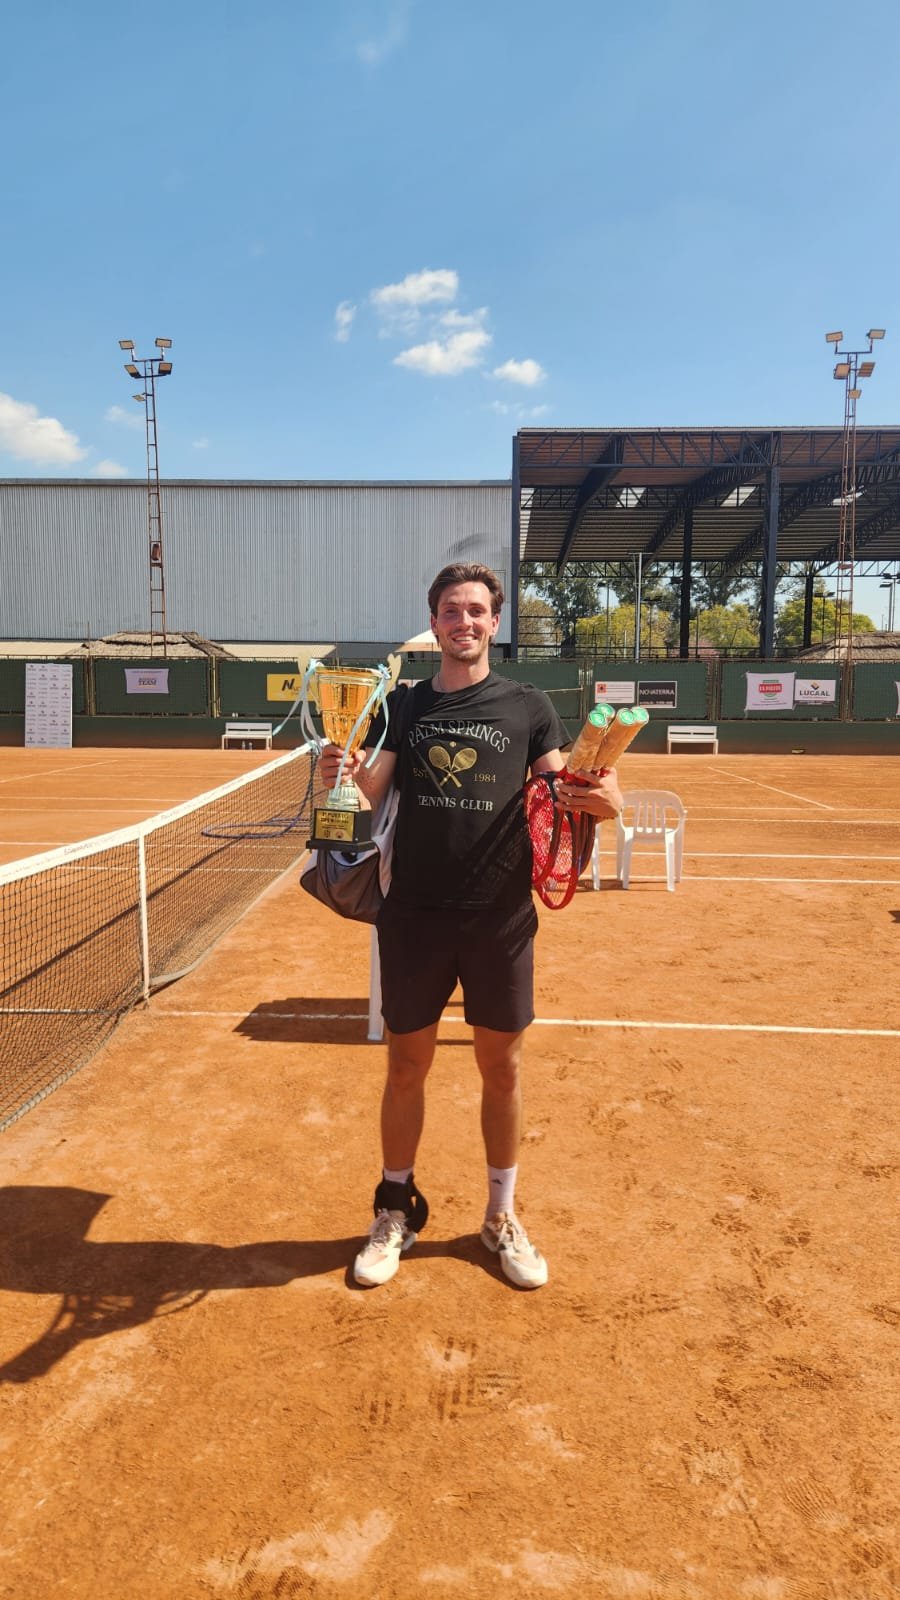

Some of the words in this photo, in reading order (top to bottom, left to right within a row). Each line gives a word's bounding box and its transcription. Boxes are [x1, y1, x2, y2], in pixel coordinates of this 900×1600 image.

[408, 722, 445, 748] PALM
[448, 721, 510, 753] SPRINGS
[474, 773, 496, 783] 1984
[418, 795, 456, 808] TENNIS
[460, 799, 493, 811] CLUB
